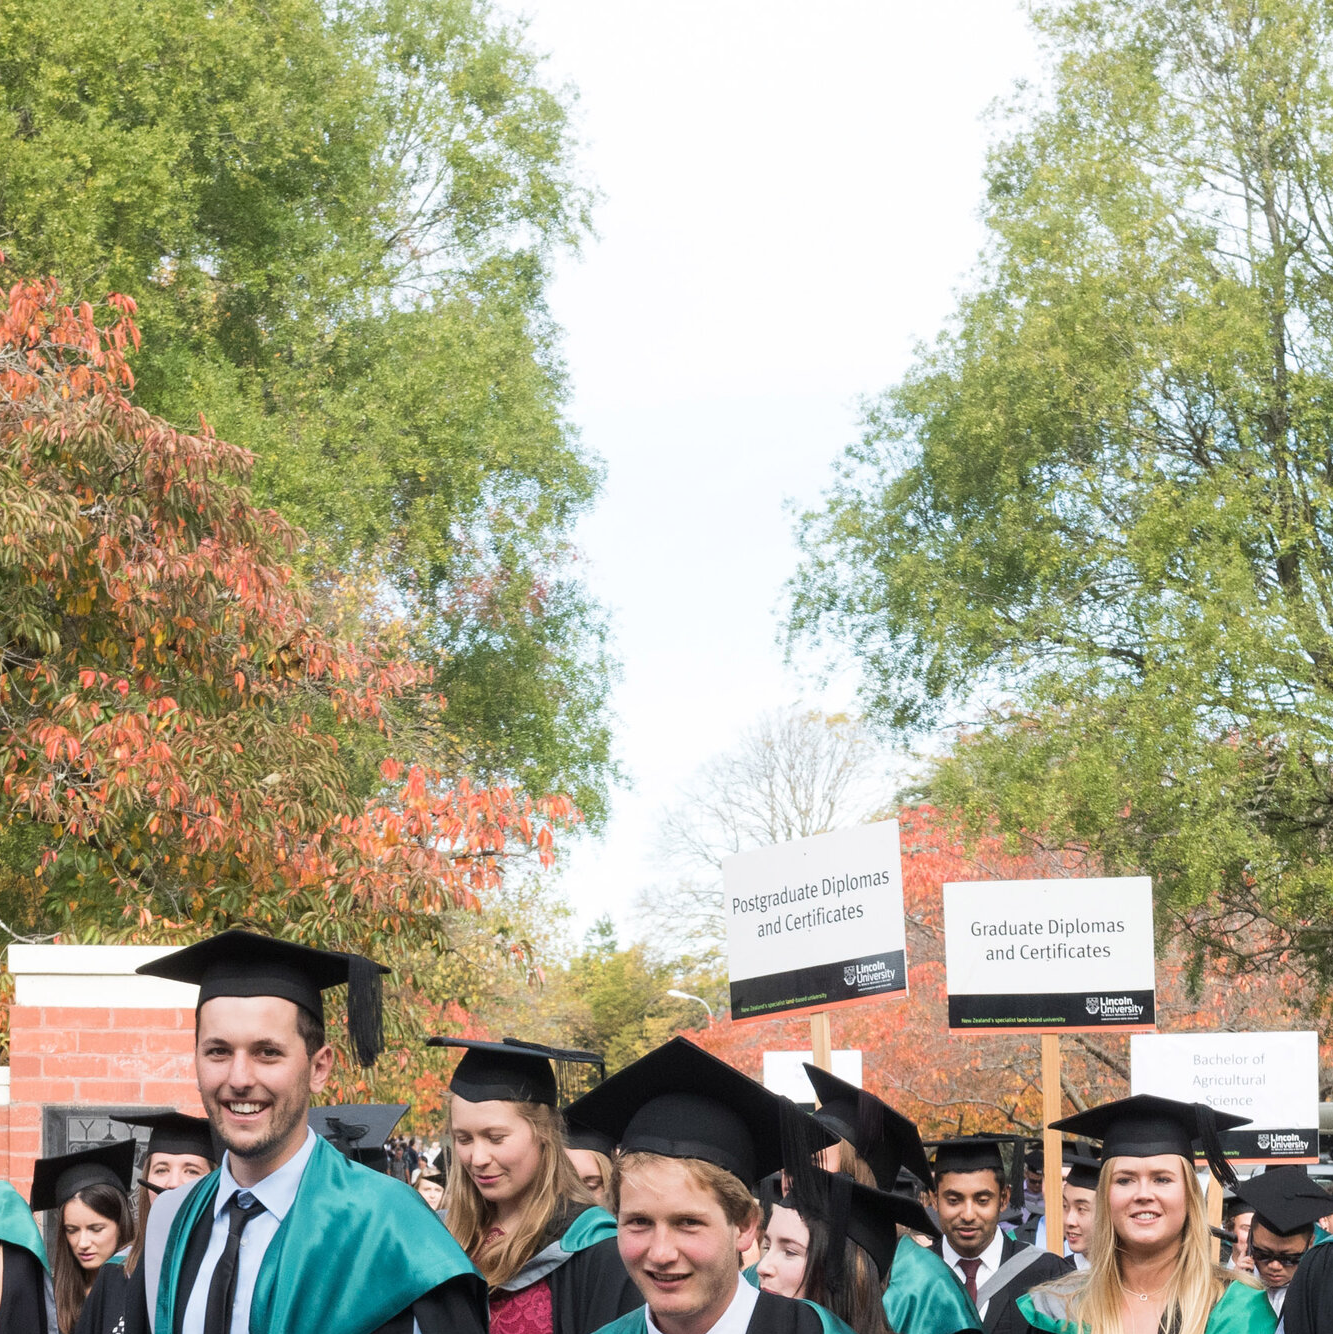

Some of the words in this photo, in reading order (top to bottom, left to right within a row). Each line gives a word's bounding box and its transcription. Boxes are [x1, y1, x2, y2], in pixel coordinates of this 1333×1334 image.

[732, 884, 818, 915] Postgraduate
[822, 870, 890, 898] Diplomas
[758, 916, 781, 938] and
[785, 904, 864, 932] Certificates
[971, 920, 1043, 937] Graduate
[1048, 918, 1125, 938] Diplomas
[986, 945, 1015, 961] and
[1020, 943, 1111, 960] Certificates
[856, 961, 885, 974] Lincoln
[857, 969, 895, 983] University
[1100, 996, 1133, 1006] Lincoln
[1100, 1004, 1144, 1015] University
[1193, 1053, 1248, 1065] Bachelor
[1252, 1053, 1265, 1065] of
[1192, 1074, 1266, 1089] Agricultural
[1205, 1095, 1253, 1106] Science
[1270, 1133, 1299, 1142] Lincoln
[1270, 1140, 1309, 1150] University
